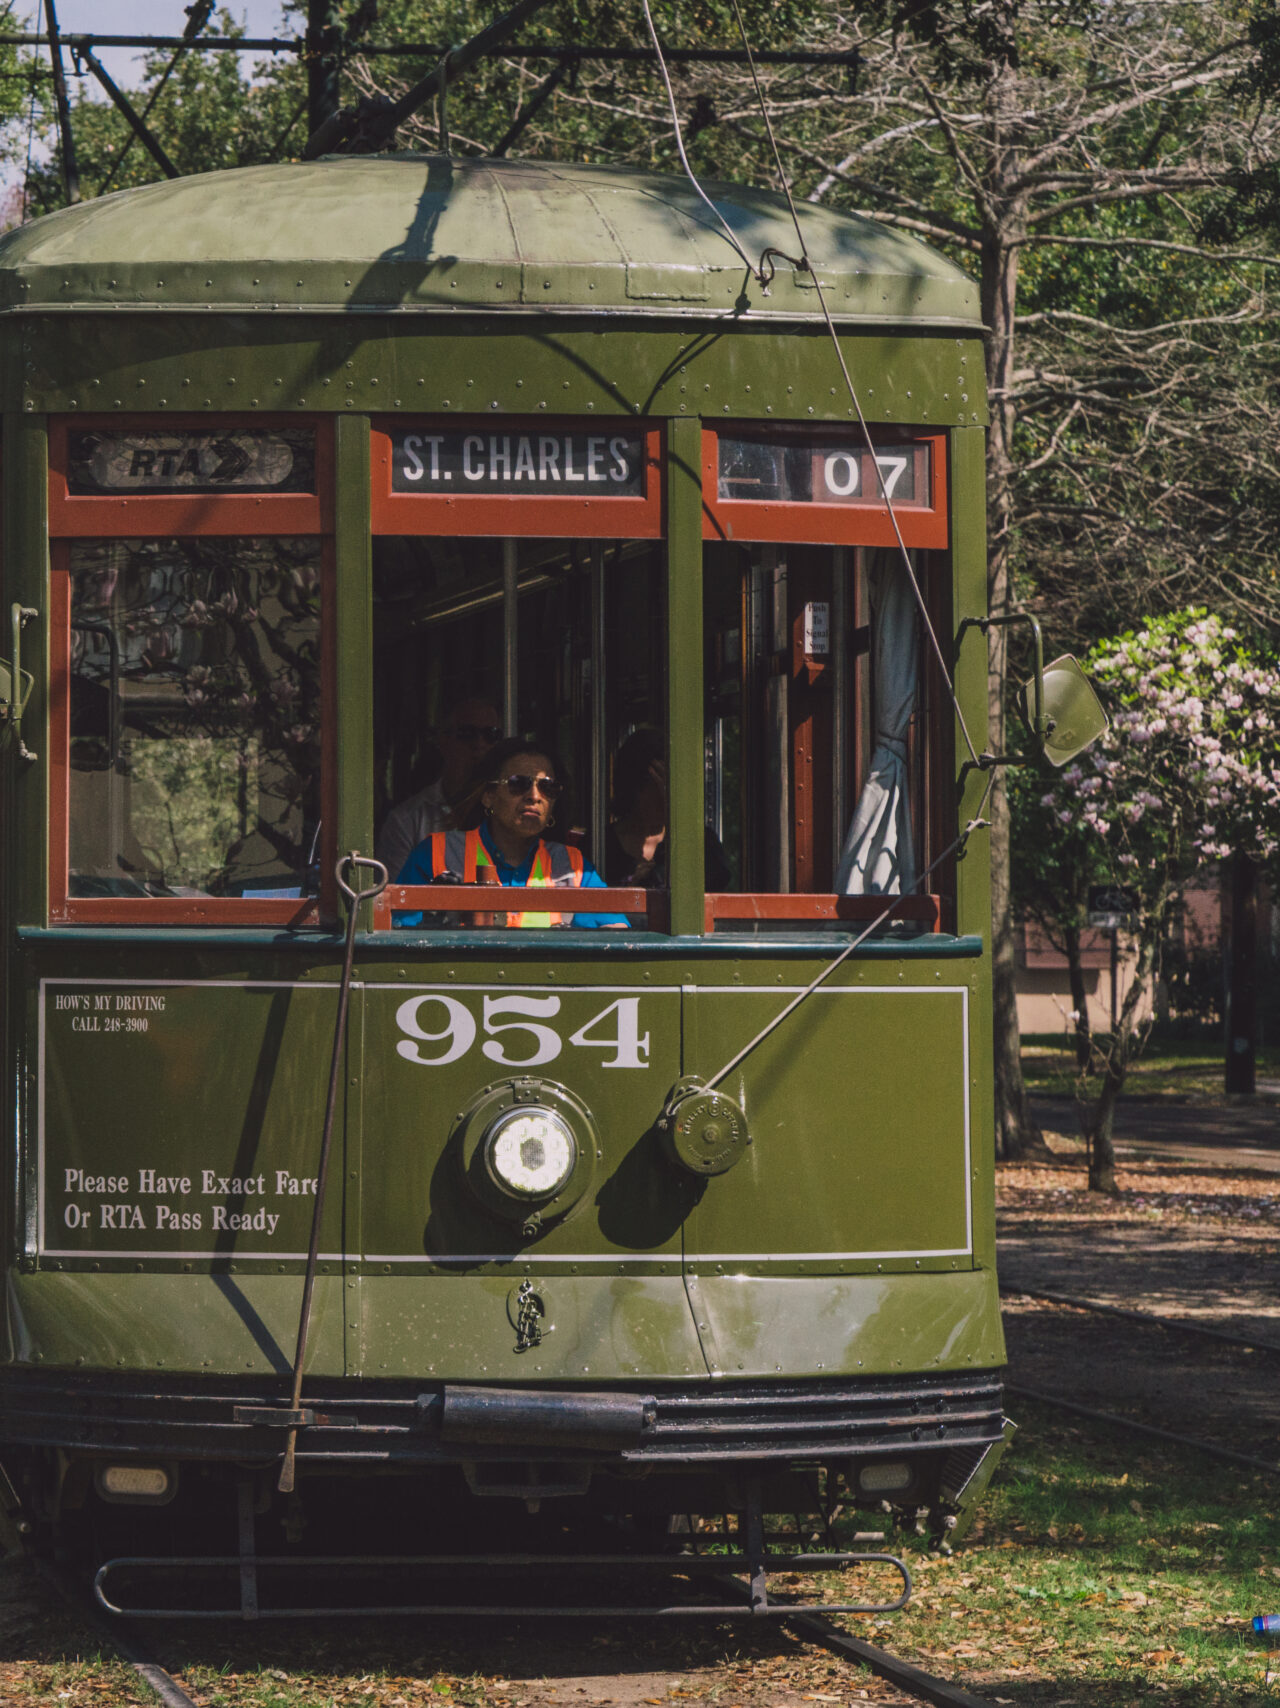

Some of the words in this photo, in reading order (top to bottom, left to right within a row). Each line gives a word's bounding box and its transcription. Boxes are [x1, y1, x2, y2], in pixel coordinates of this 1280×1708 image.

[129, 449, 202, 477] RTA
[403, 436, 452, 480] ST.
[463, 436, 629, 481] CHARLES
[808, 602, 826, 612] Push
[813, 615, 823, 625] To
[806, 629, 828, 639] Signal
[809, 641, 826, 652] Stop
[56, 995, 90, 1010] HOW'S
[94, 995, 112, 1010] MY
[116, 995, 166, 1011] DRIVING
[72, 1016, 100, 1032] CALL
[104, 1017, 148, 1032] 248-3900
[395, 994, 650, 1069] 954
[64, 1168, 129, 1193] Please
[138, 1169, 192, 1194] Have
[201, 1170, 265, 1195] Exact
[64, 1203, 91, 1229] Or
[100, 1205, 146, 1229] RTA
[155, 1205, 202, 1230] Pass
[212, 1206, 280, 1236] Ready
